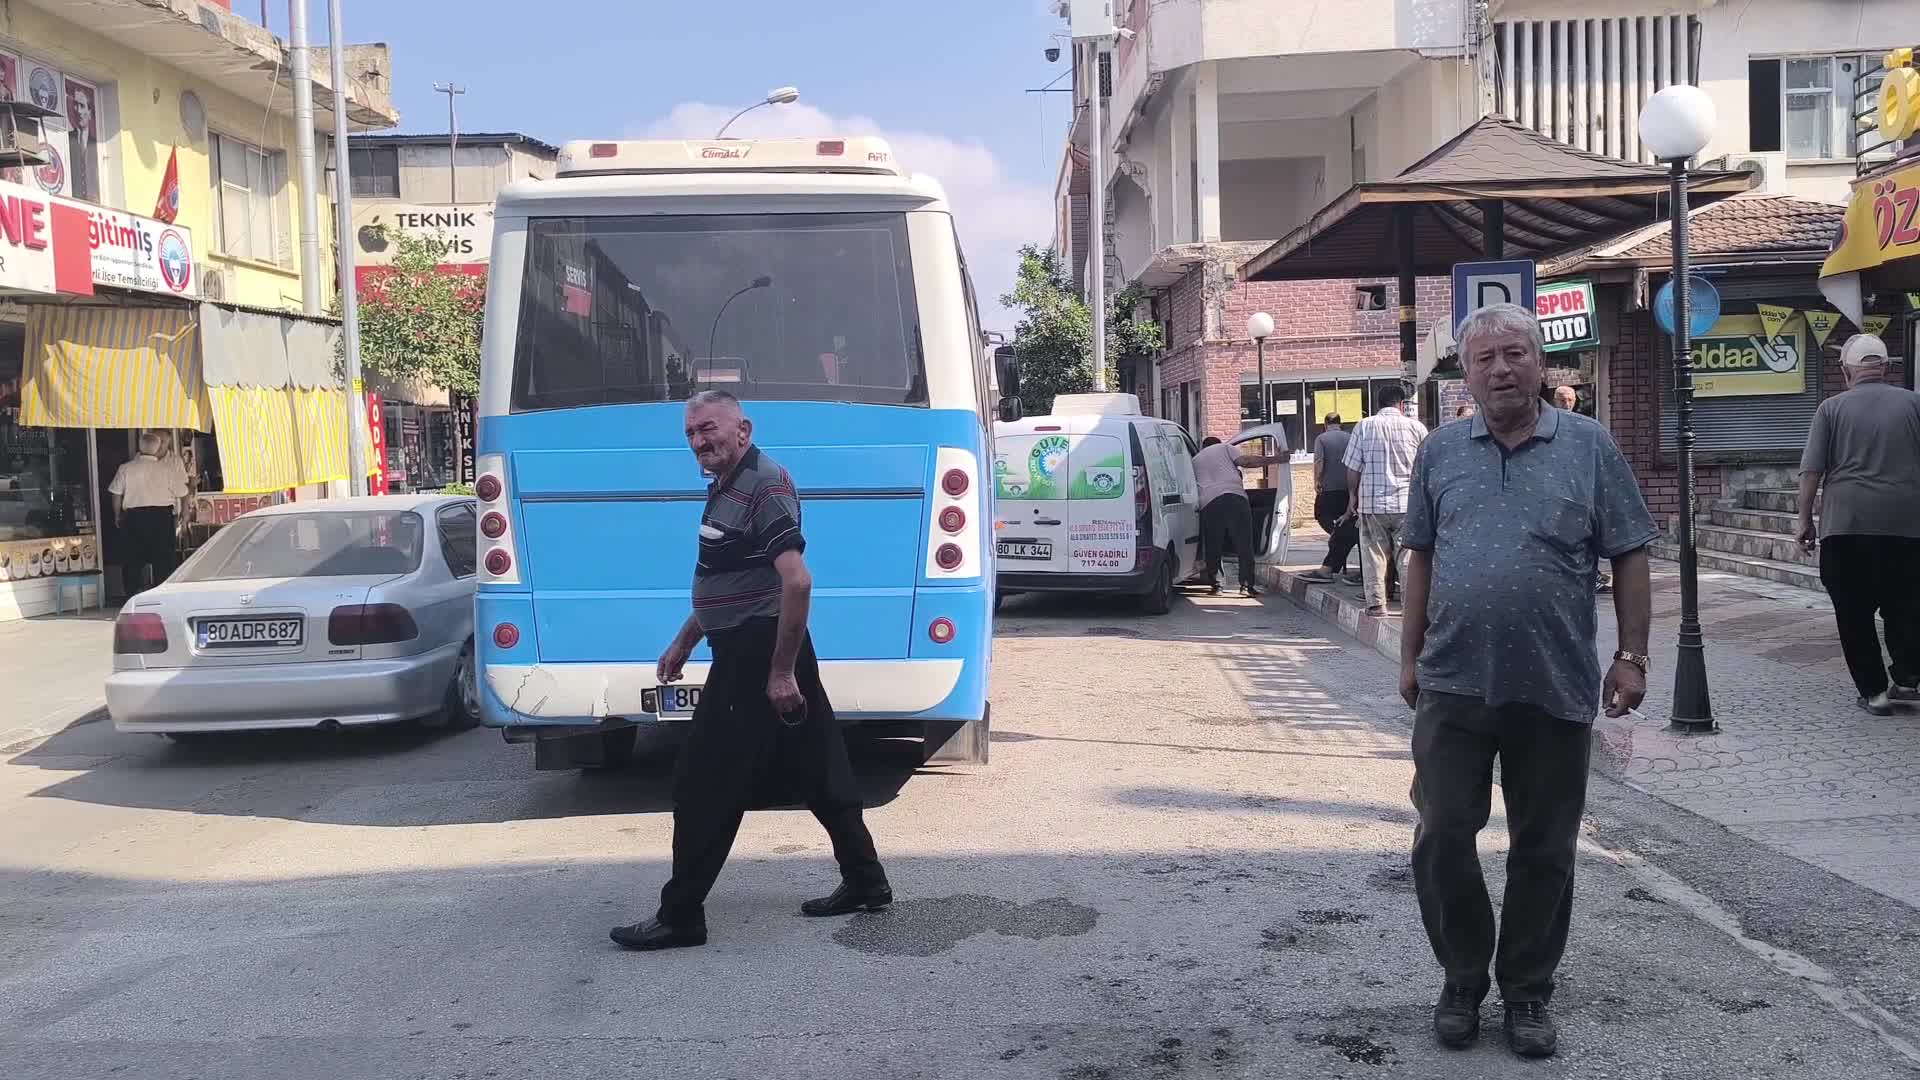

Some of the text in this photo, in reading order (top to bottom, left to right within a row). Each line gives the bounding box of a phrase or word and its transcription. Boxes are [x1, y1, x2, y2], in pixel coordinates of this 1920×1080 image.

[395, 207, 476, 228] TEKNİK
[88, 211, 153, 261] ğitimiş
[1536, 289, 1586, 316] SPOR
[1540, 316, 1587, 342] TOTO
[1690, 343, 1758, 370] ddaa
[998, 544, 1050, 556] 80 LK 344
[1073, 549, 1098, 559] GÜVEN
[207, 621, 299, 641] 80 ADR 687
[675, 687, 702, 708] 80
